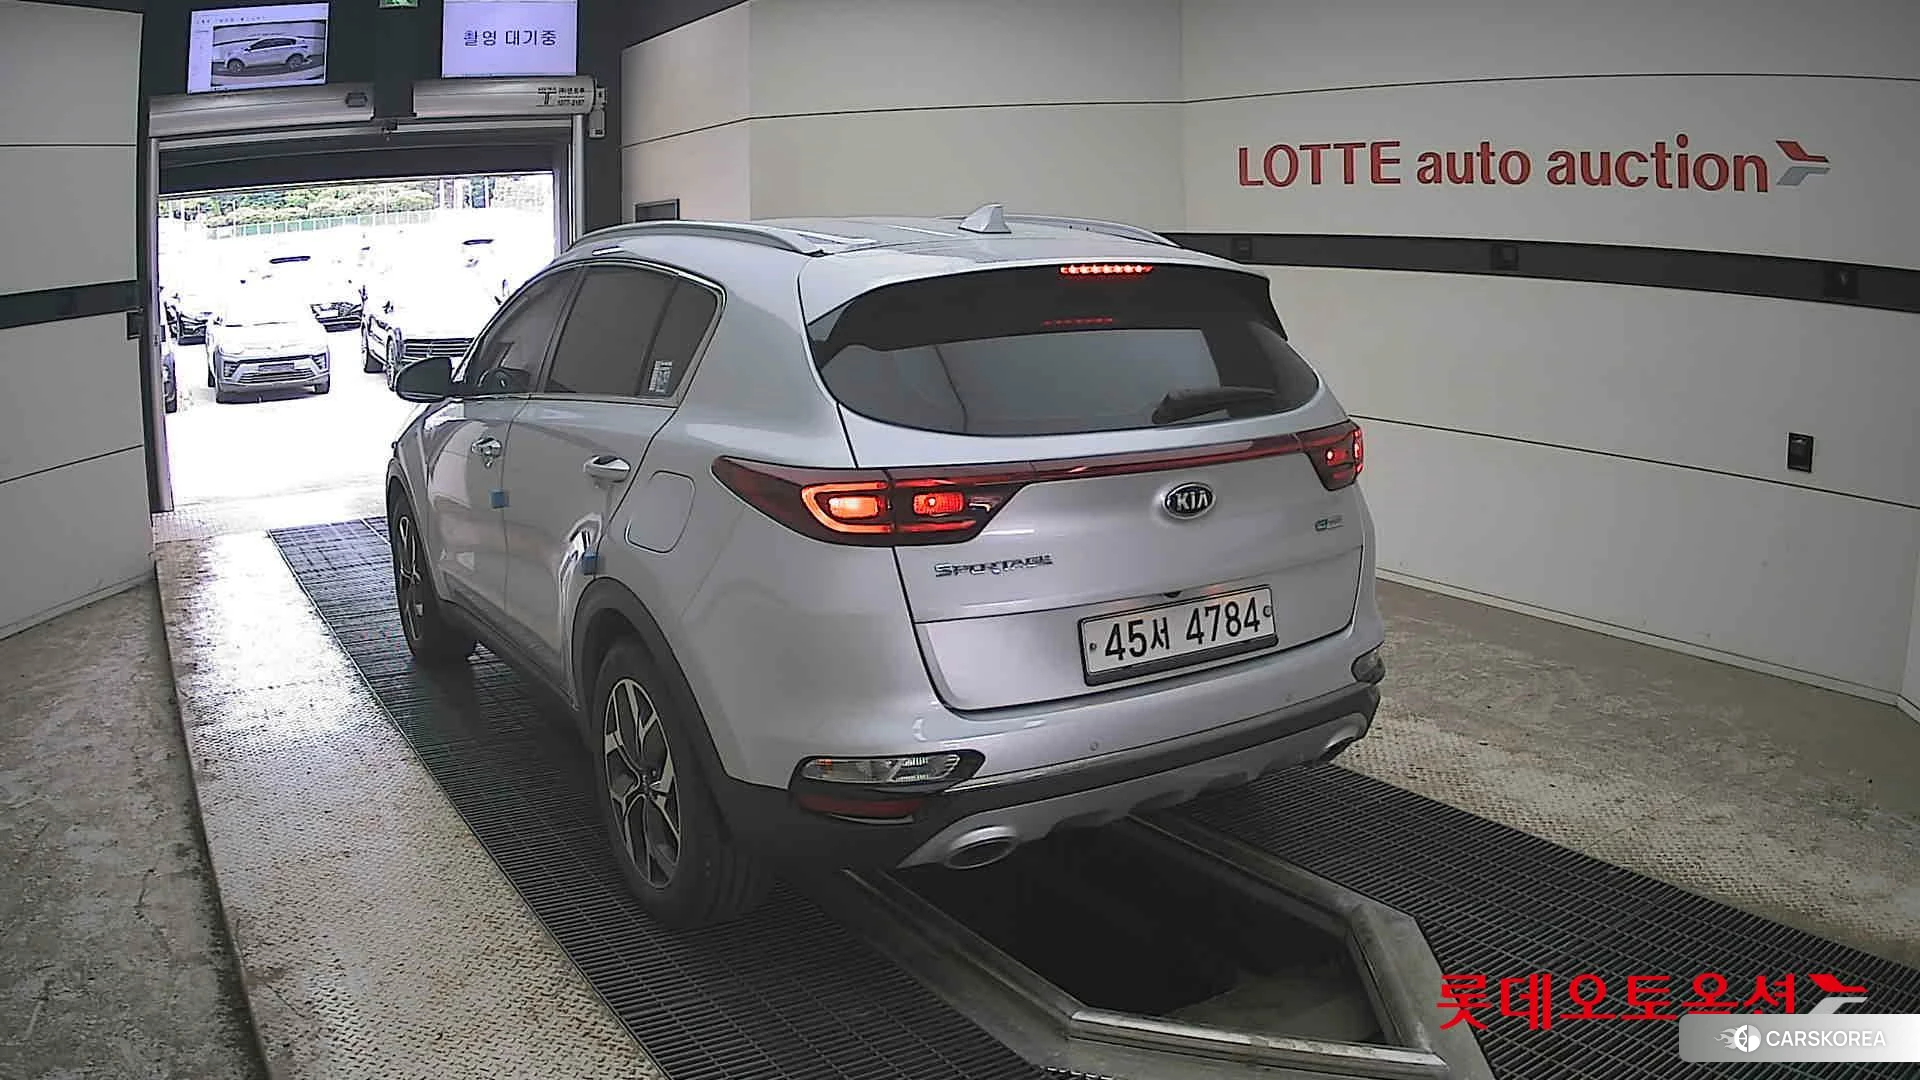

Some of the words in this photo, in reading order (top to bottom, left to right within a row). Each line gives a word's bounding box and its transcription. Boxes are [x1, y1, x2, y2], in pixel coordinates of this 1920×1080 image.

[463, 29, 497, 47] 촬영
[504, 29, 557, 47] 대기중
[1238, 140, 1401, 188] LOTTE
[1416, 141, 1532, 185] auto
[1546, 133, 1768, 193] auction
[1175, 490, 1209, 511] KIA
[934, 554, 1054, 578] SPORTAGE
[1104, 616, 1171, 661] 45서
[1185, 596, 1261, 645] 4784
